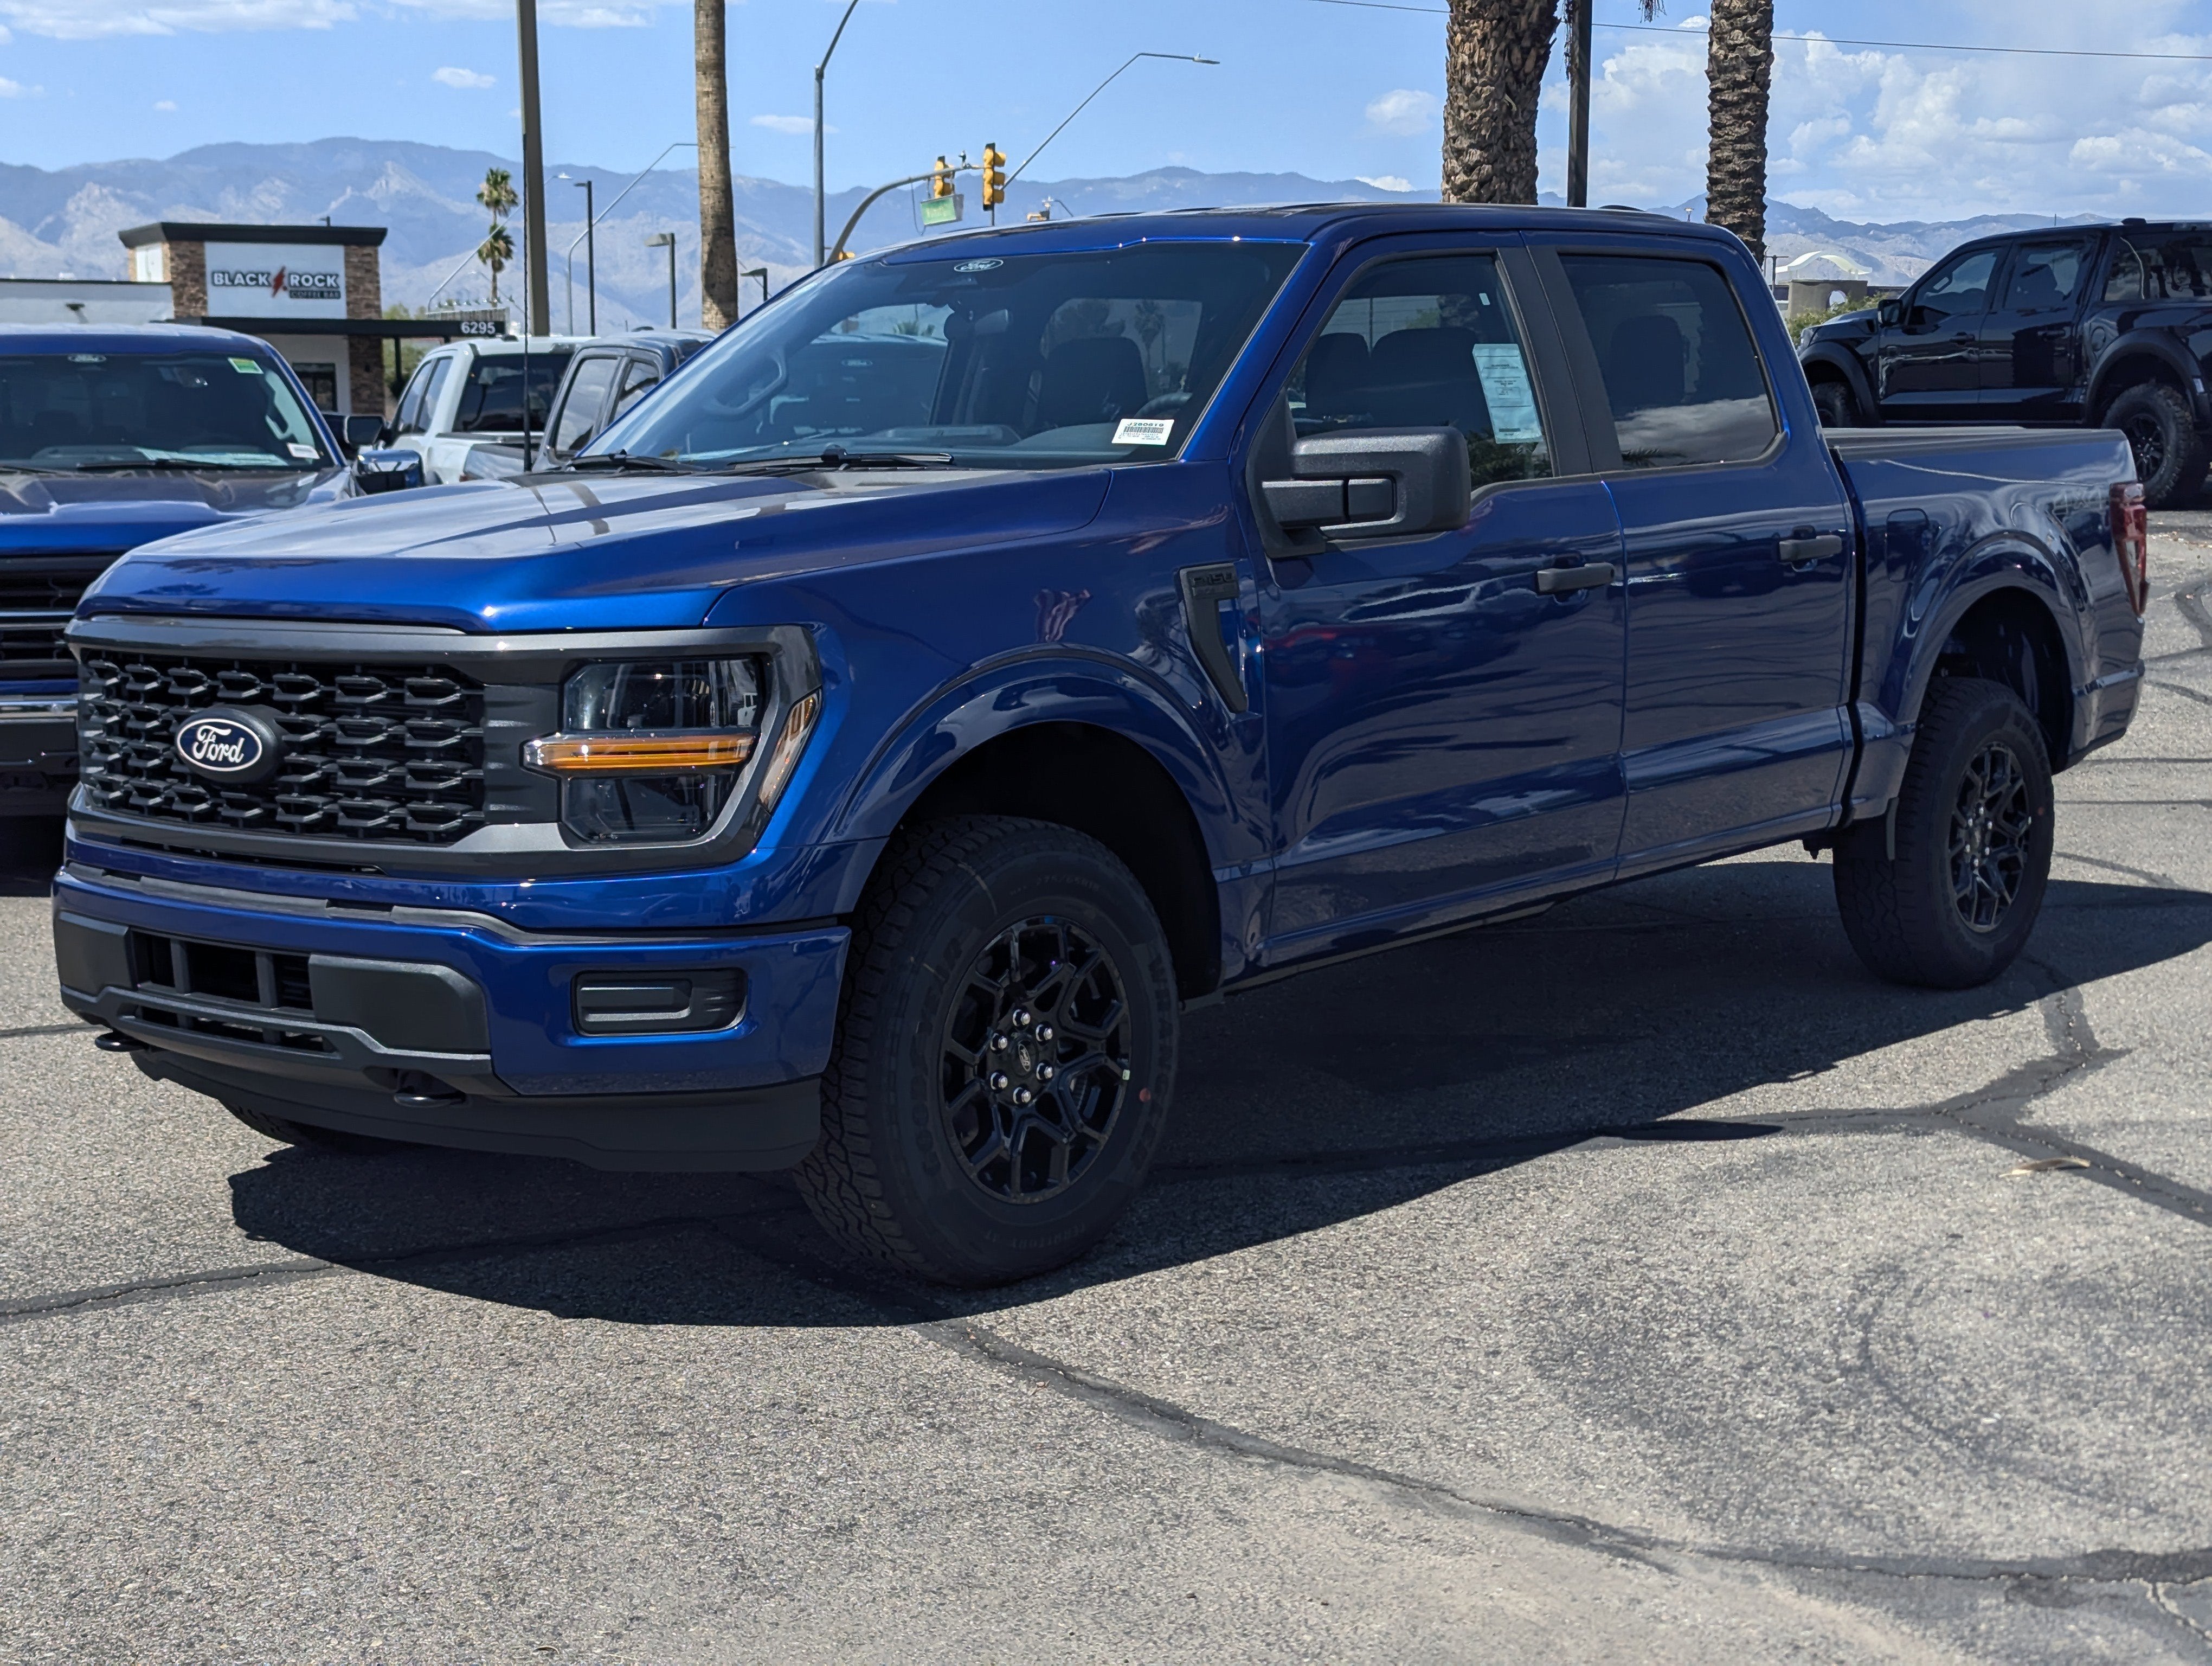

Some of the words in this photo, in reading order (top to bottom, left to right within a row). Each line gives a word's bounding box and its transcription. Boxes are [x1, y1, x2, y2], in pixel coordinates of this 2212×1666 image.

[213, 272, 271, 286] BLACK
[290, 273, 339, 287] ROCK
[461, 322, 496, 335] 6295
[192, 725, 245, 763] Ford
